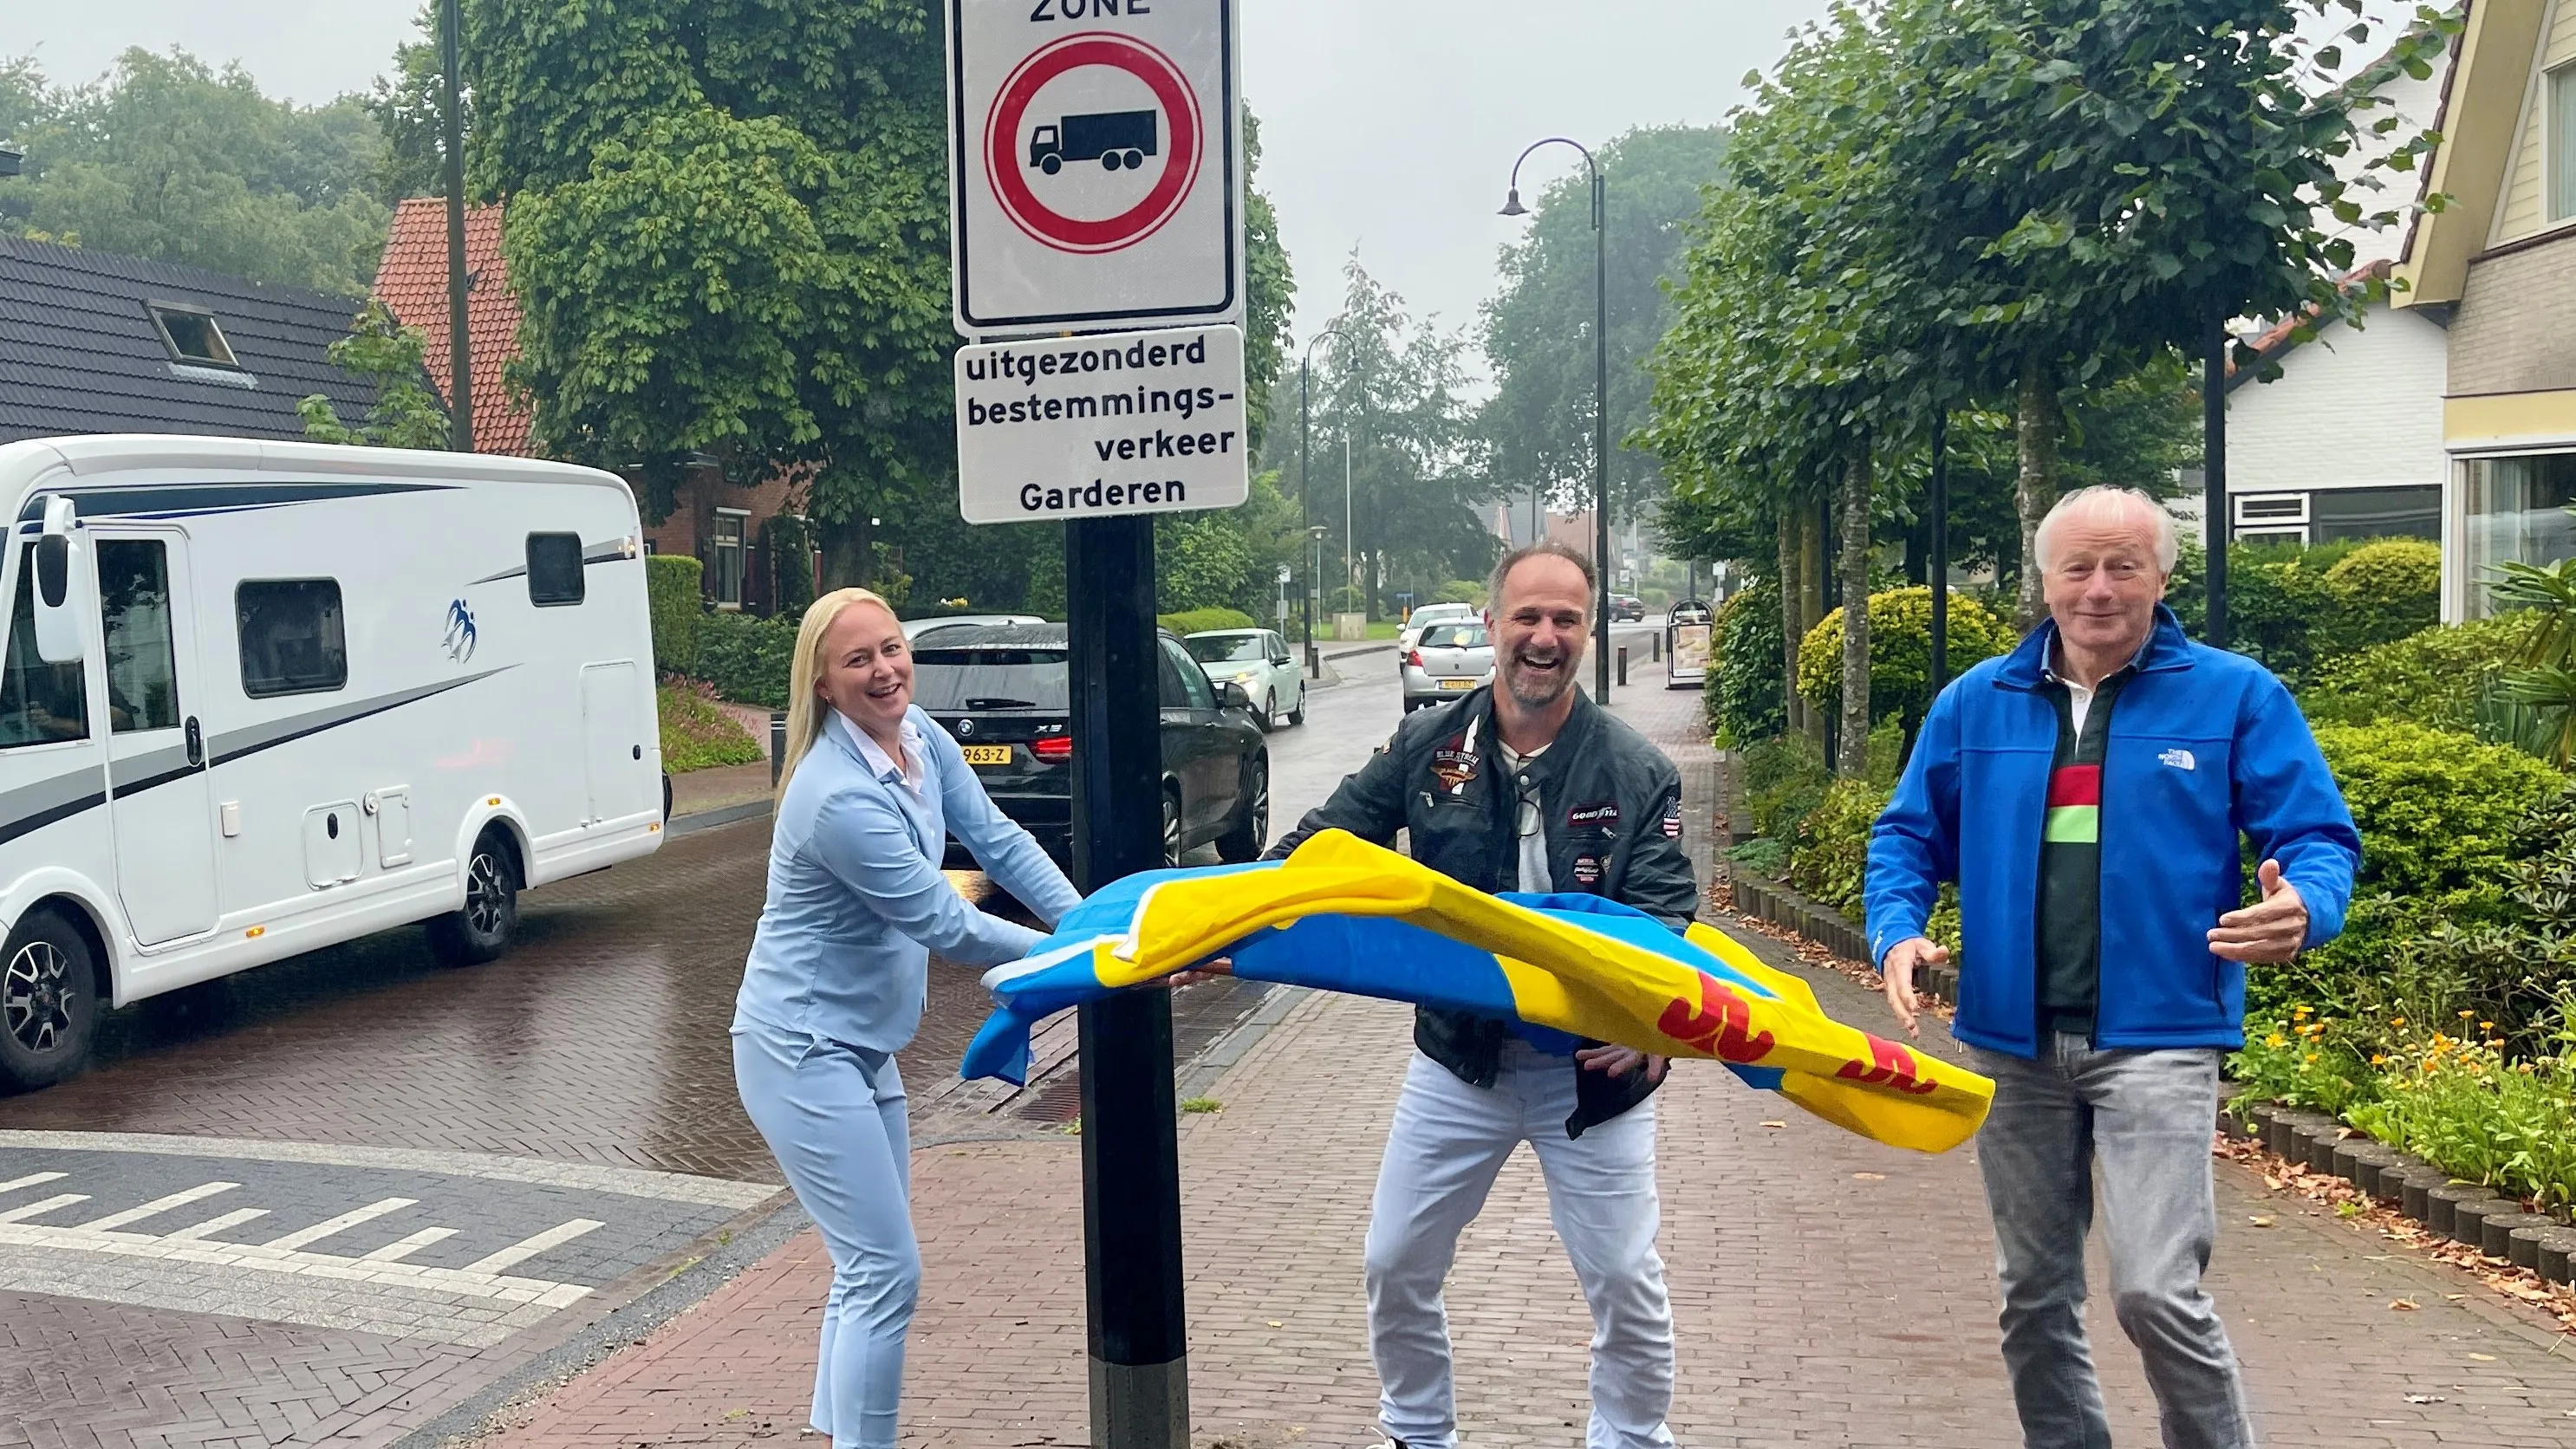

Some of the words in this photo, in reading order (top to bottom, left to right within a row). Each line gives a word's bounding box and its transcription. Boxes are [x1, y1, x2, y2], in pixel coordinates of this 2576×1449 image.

[966, 335, 1206, 386] uitgezonderd
[967, 387, 1234, 426] bestemmings-
[1095, 428, 1235, 462] verkeer
[1020, 477, 1186, 511] Garderen
